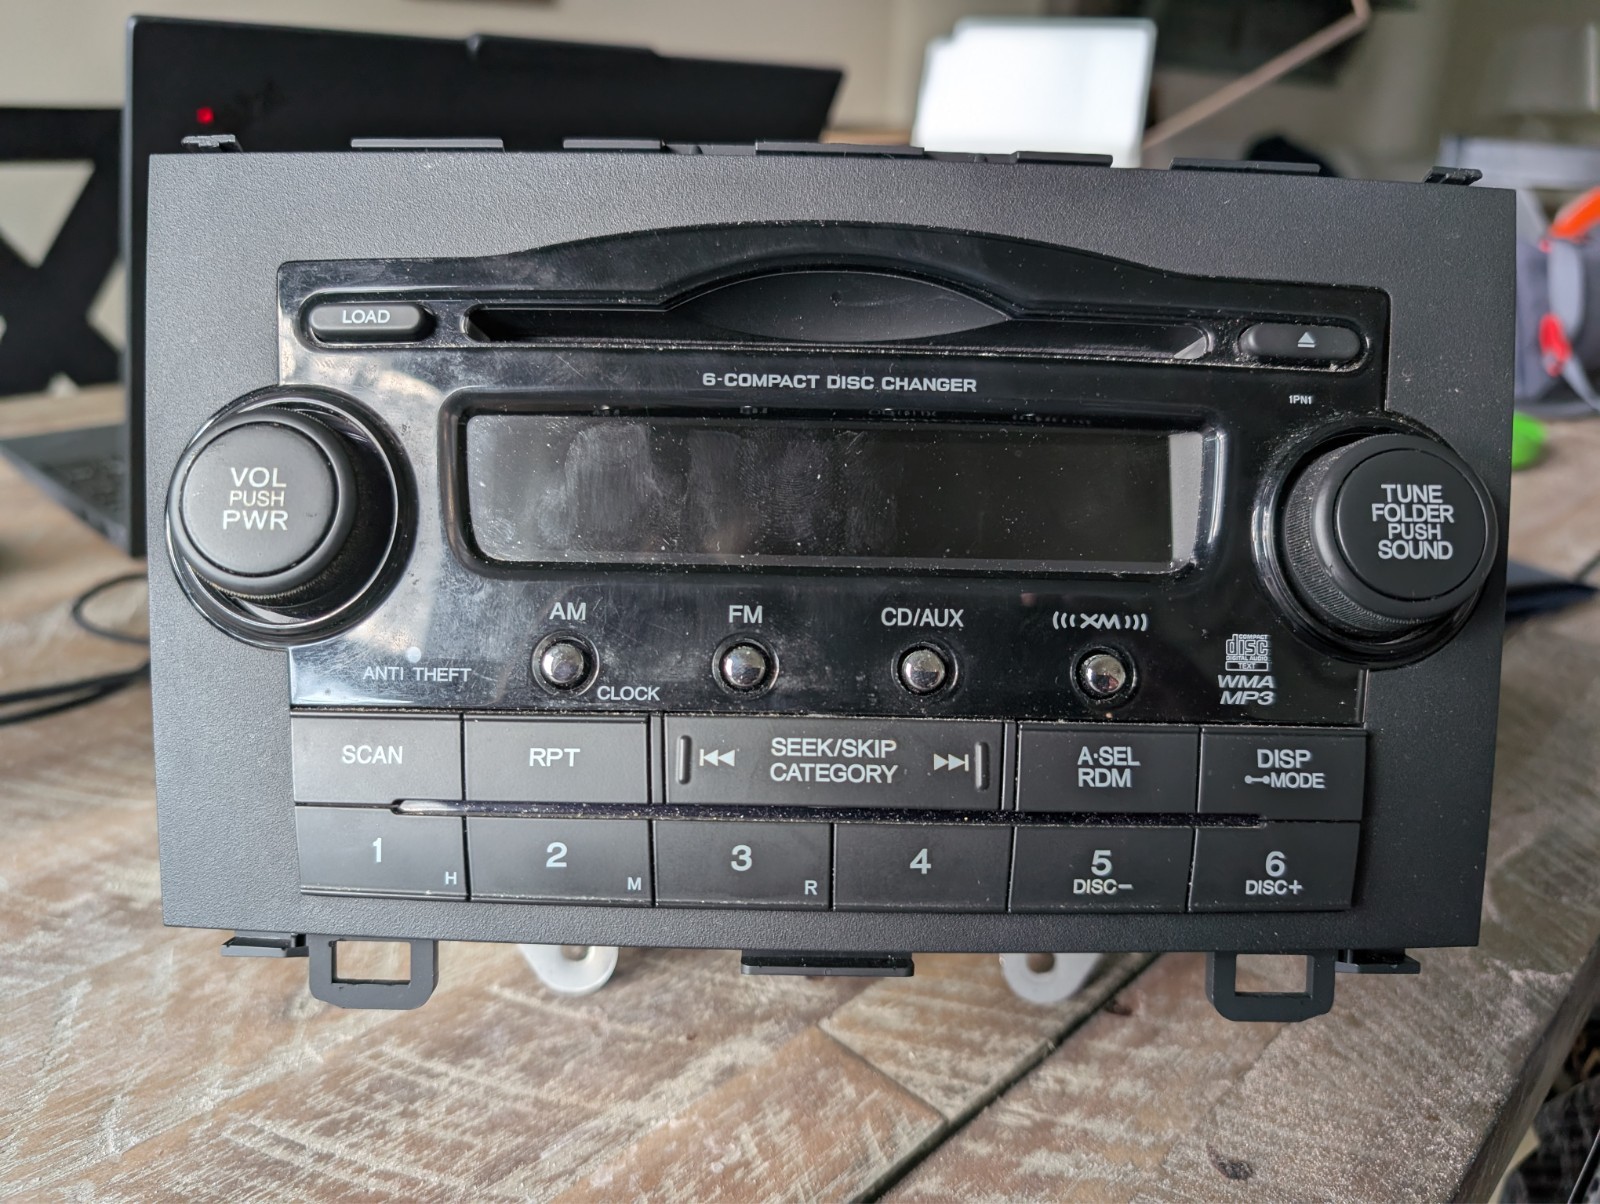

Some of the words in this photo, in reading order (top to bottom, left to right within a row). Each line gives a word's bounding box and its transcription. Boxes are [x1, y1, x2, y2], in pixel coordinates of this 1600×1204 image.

[342, 310, 391, 324] LOAD
[702, 372, 820, 390] 6-COMPACT
[827, 374, 876, 391] DISC
[881, 375, 978, 393] CHANGER
[230, 466, 287, 488] VOL
[229, 489, 285, 507] PUSH
[1381, 483, 1443, 503] TUNE
[222, 509, 289, 531] PWR
[1371, 503, 1455, 523] FOLDER
[1388, 523, 1441, 540] PUSH
[1378, 540, 1453, 560] SOUND
[549, 602, 587, 621] AM
[728, 604, 763, 624] FM
[881, 607, 964, 628] CD/AUX
[363, 666, 404, 681] ANTI
[412, 667, 471, 682] THEFT
[1238, 662, 1256, 670] TEXT
[1218, 674, 1275, 688] WMA
[597, 685, 660, 702] CLOCK
[1220, 690, 1275, 705] MP3
[342, 744, 403, 765] SCAN
[529, 747, 580, 768] RPT
[771, 737, 897, 759] SEEK/SKIP
[1256, 748, 1311, 770] DISP
[769, 762, 898, 784] CATEGORY
[1077, 768, 1132, 788] RDM
[1270, 772, 1325, 789] MODE
[371, 837, 383, 863] 1
[546, 842, 568, 869] 2
[730, 844, 753, 872] 3
[909, 848, 932, 874] 4
[1090, 849, 1112, 877] 5
[1265, 851, 1286, 877] 6
[444, 871, 457, 885] H
[626, 876, 642, 891] M
[803, 879, 818, 896] R
[1245, 878, 1303, 896] DISC+
